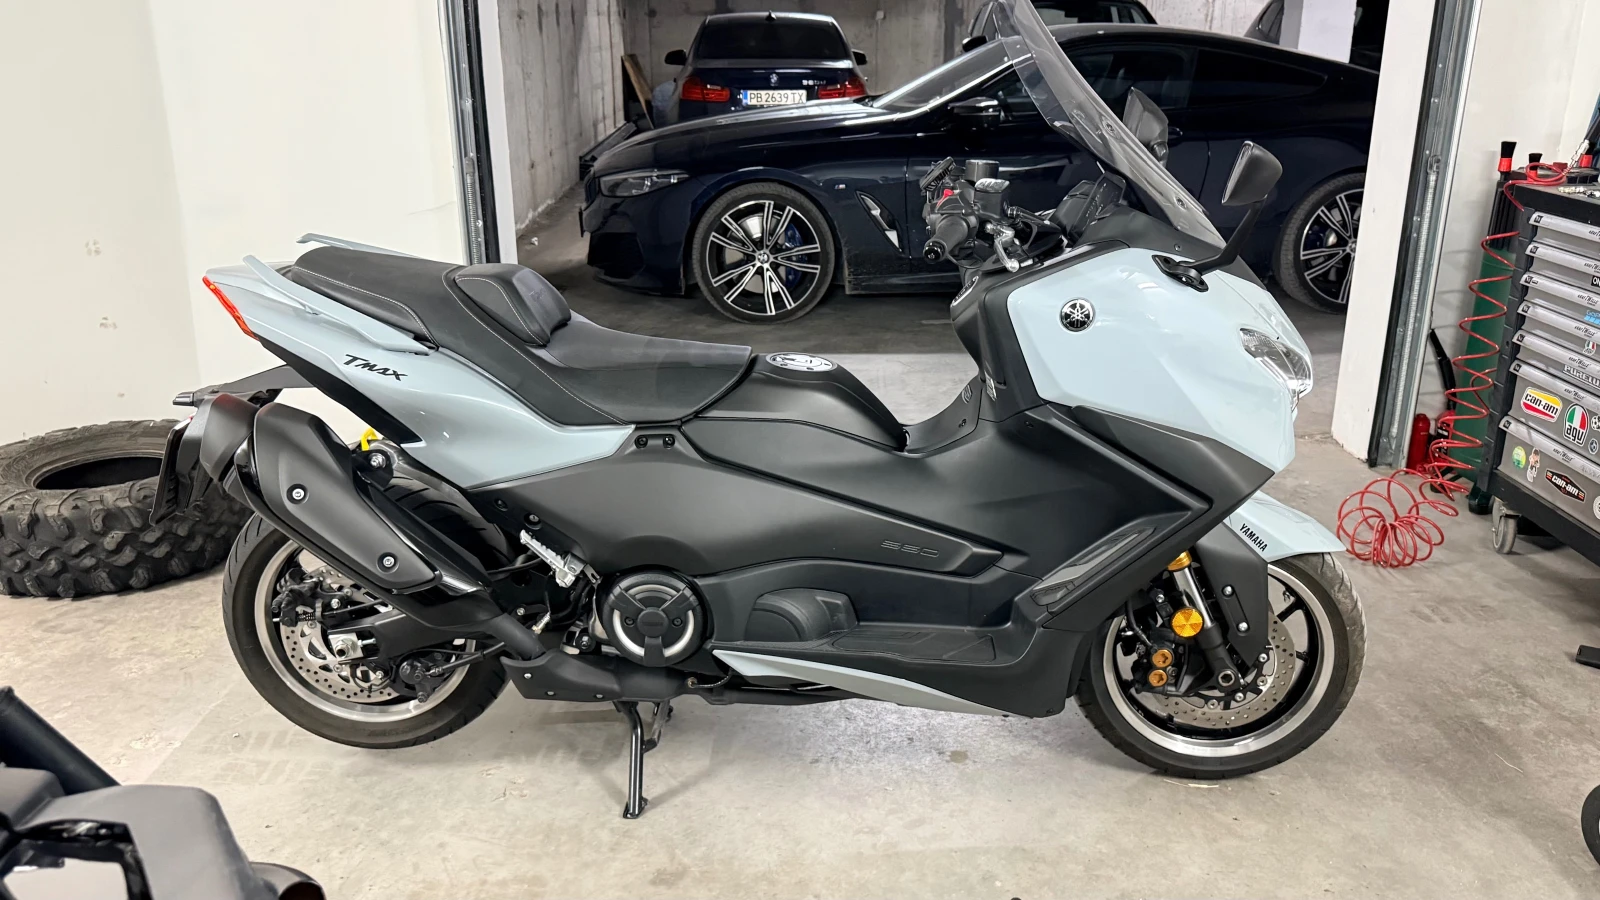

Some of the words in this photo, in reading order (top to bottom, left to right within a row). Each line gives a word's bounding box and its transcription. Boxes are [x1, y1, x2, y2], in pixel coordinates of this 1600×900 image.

[750, 92, 763, 103] PB
[764, 92, 789, 103] 2639
[790, 92, 804, 104] TX
[1523, 393, 1559, 416] can-am
[1551, 474, 1580, 496] can-am
[1239, 523, 1268, 552] YAMAHA
